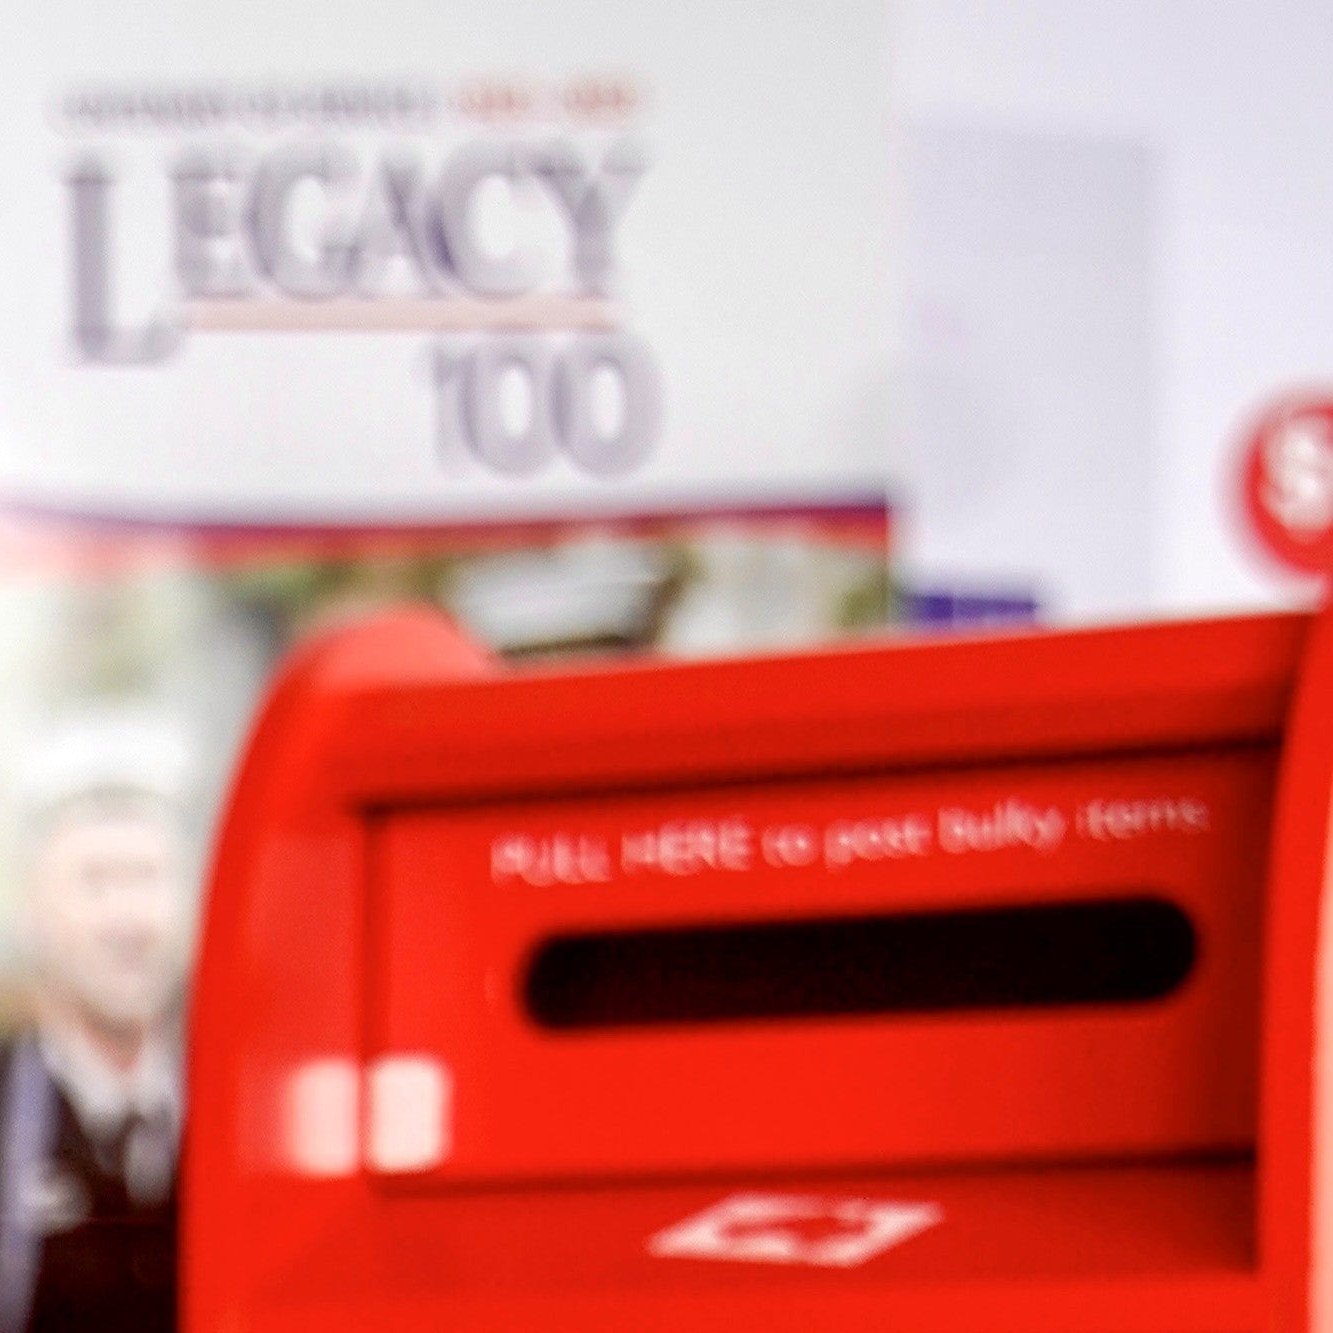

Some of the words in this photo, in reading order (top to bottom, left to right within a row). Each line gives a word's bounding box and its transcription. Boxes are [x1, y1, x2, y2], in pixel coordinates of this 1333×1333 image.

[65, 138, 648, 367] LEGACY
[429, 334, 665, 480] 100
[490, 830, 611, 887] PULL
[621, 815, 753, 876] HERE
[760, 822, 819, 868] to
[825, 813, 932, 876] post
[1075, 798, 1212, 842] items
